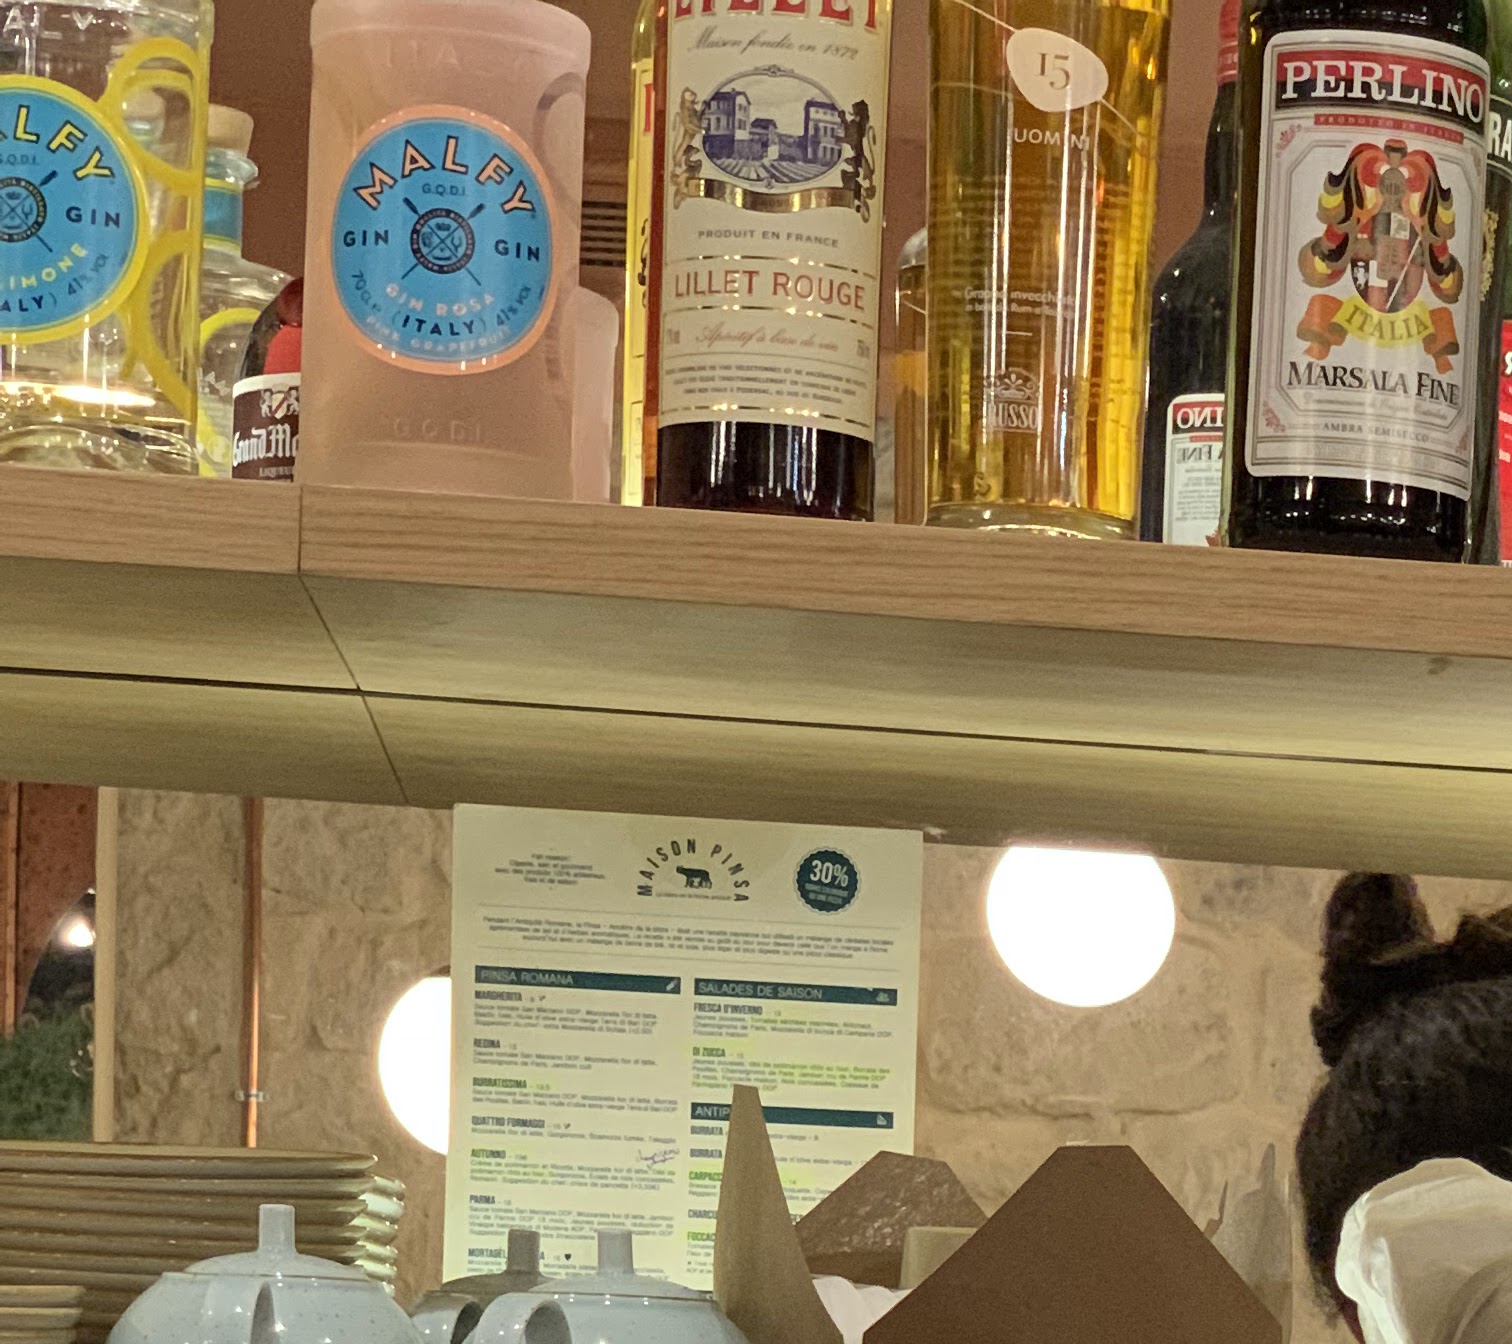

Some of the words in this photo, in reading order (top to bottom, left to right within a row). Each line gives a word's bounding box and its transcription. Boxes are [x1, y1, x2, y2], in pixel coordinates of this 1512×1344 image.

[1036, 52, 1071, 91] 15
[1282, 60, 1484, 124] PERLINO
[0, 104, 115, 181] LFY
[353, 135, 536, 211] MALFY
[66, 206, 120, 228] GIN
[343, 230, 389, 247] GIN
[494, 239, 540, 262] GIN
[698, 230, 756, 240] PRODUIT
[762, 230, 780, 240] EN
[786, 230, 839, 248] FRANCE
[7, 242, 88, 289] IMONE
[436, 293, 495, 317] ROSA
[674, 269, 760, 298] LILLET
[771, 272, 866, 311] ROUGE
[1345, 305, 1430, 341] ITALIA
[1287, 360, 1409, 395] MARSALA
[1415, 371, 1462, 407] FINE
[1323, 422, 1363, 434] AMBRA
[636, 837, 698, 899] MAISON
[711, 843, 751, 903] PINSA
[808, 858, 850, 889] 30%
[481, 969, 517, 982] PINSA
[520, 971, 575, 986] ROMANA
[699, 981, 754, 996] SALADES
[757, 986, 774, 997] DE
[777, 987, 823, 1000] SAISON
